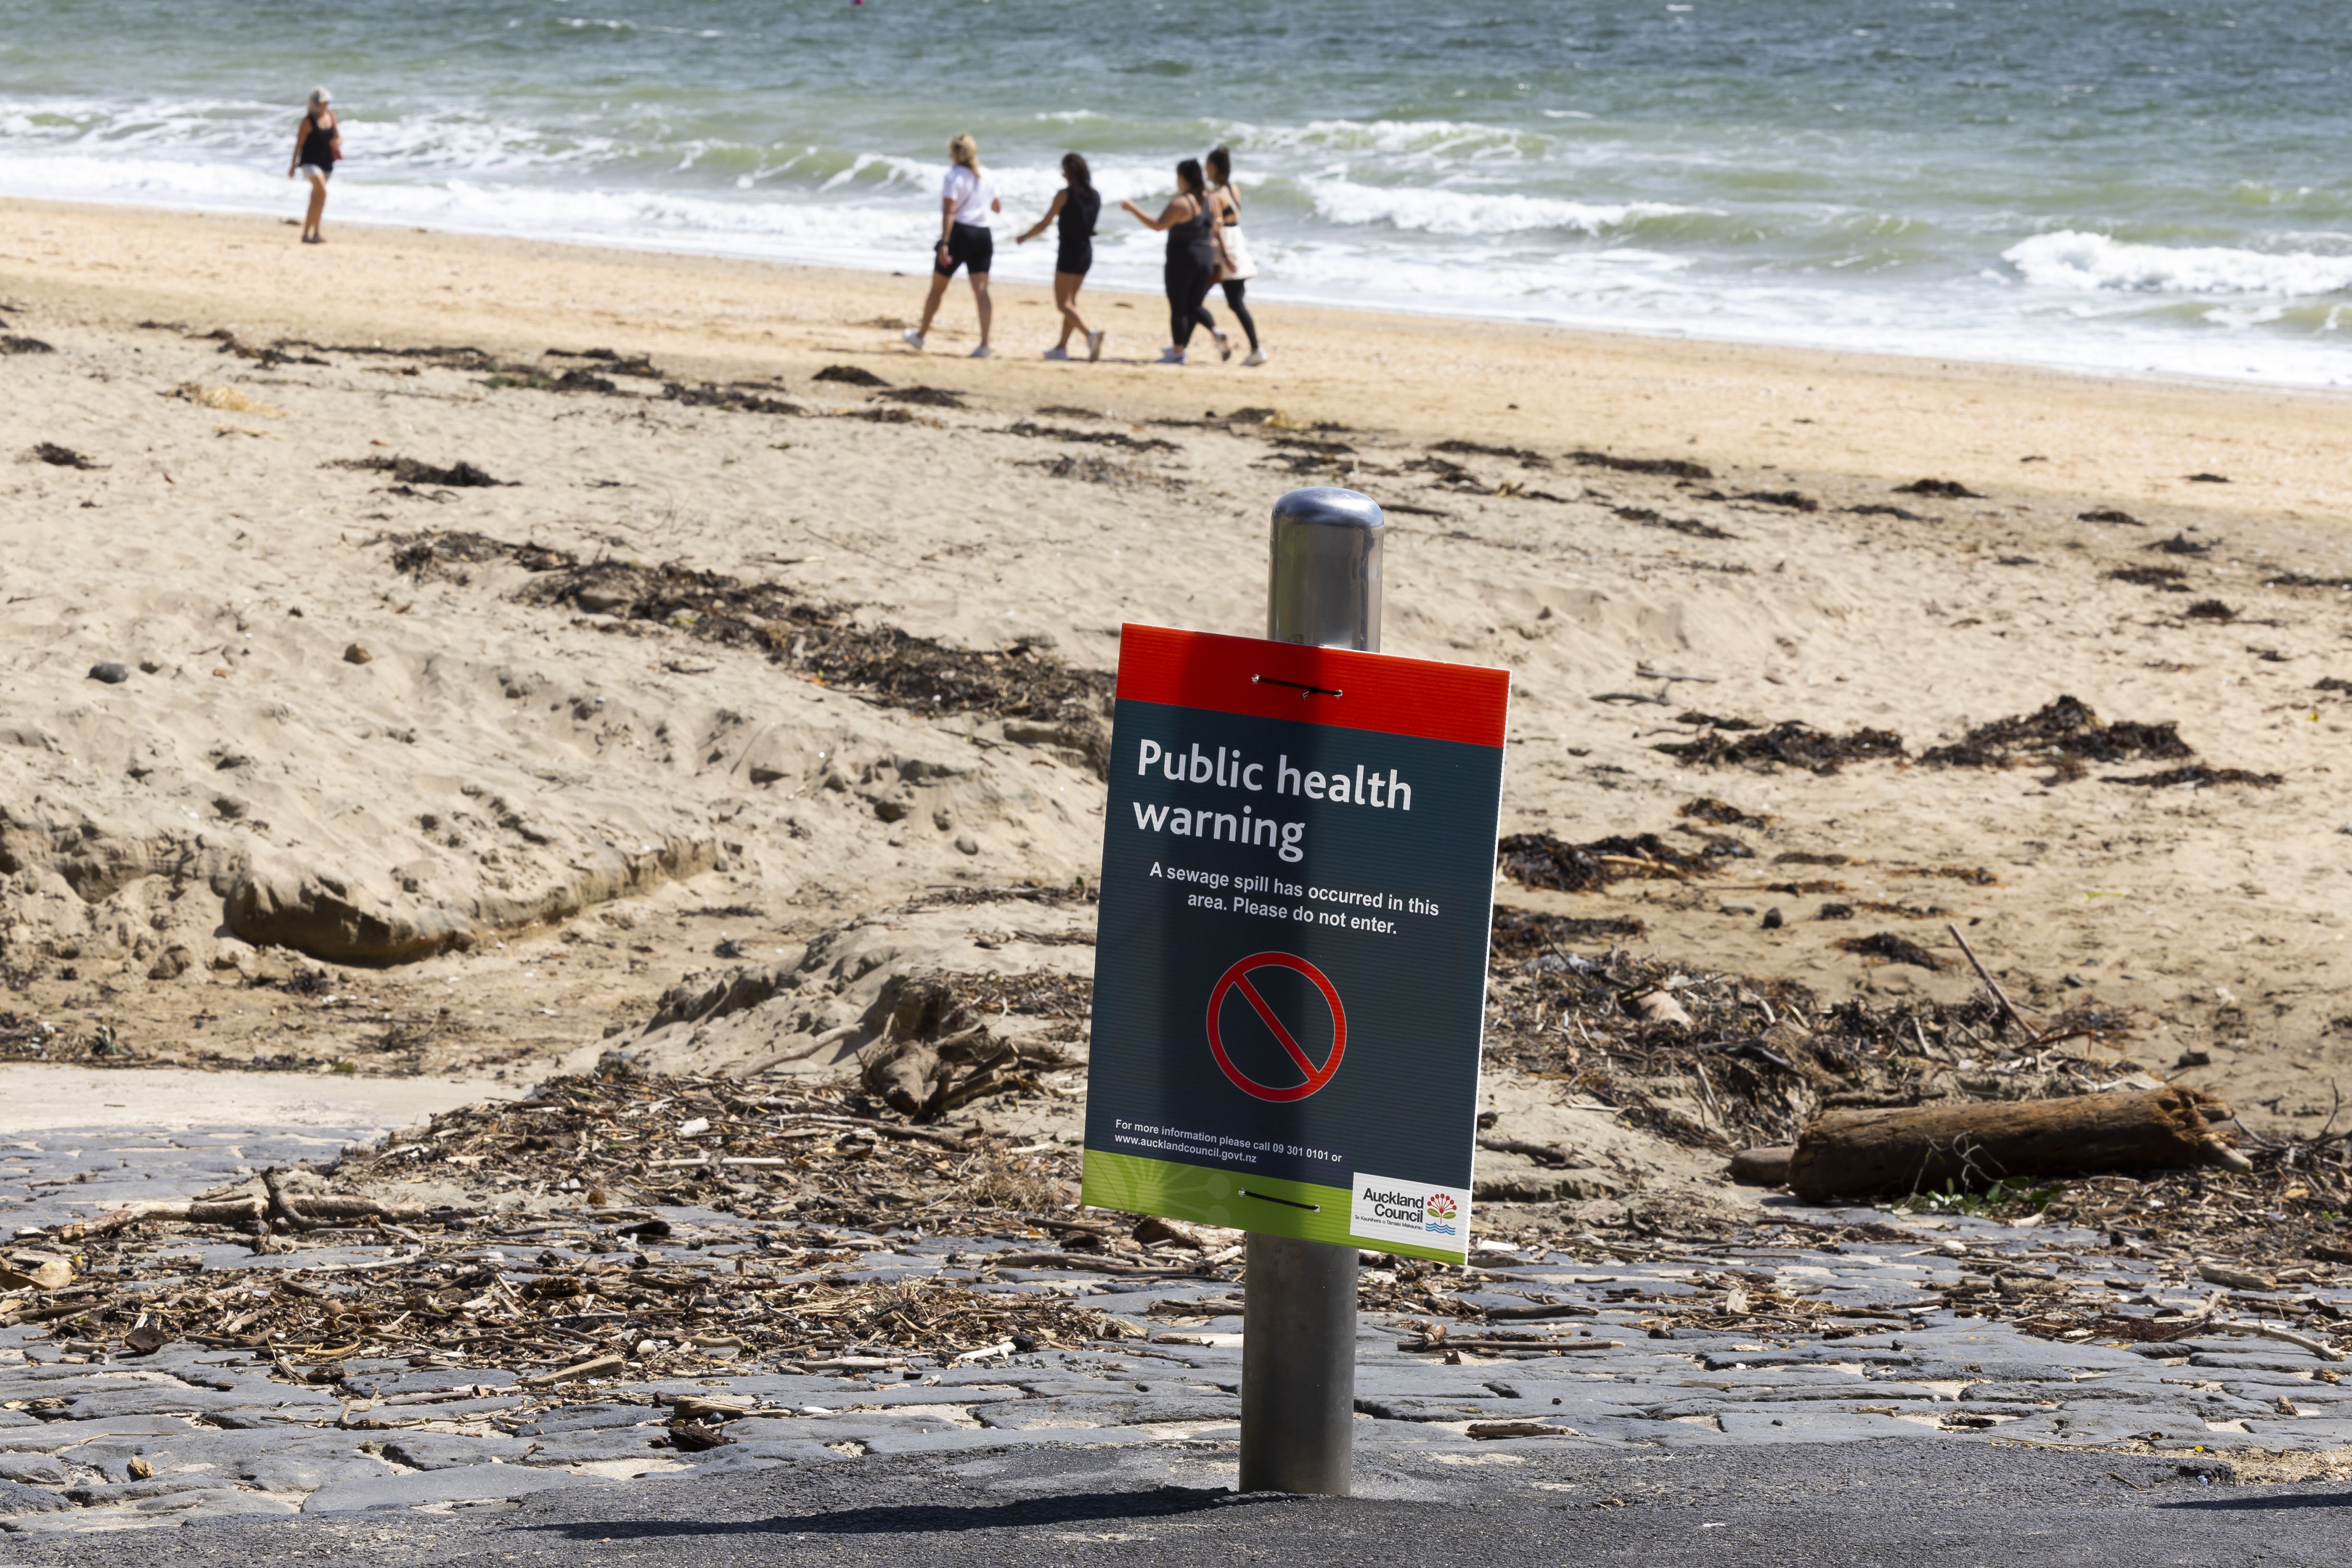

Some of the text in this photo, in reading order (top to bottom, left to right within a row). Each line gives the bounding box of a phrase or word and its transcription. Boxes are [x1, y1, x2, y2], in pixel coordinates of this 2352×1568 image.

[1138, 739, 1411, 811] Public health
[1133, 802, 1306, 862] warning
[1149, 861, 1439, 916] A sewage spill has occurred in this
[1187, 894, 1397, 935] area. Please do not enter.
[1114, 1134, 1257, 1163] www.aucklandcouncil.govt.nz
[1115, 1119, 1342, 1162] For more information please call 09 301 0101 or
[1363, 1187, 1424, 1209] Auckland
[1375, 1203, 1423, 1223] Council
